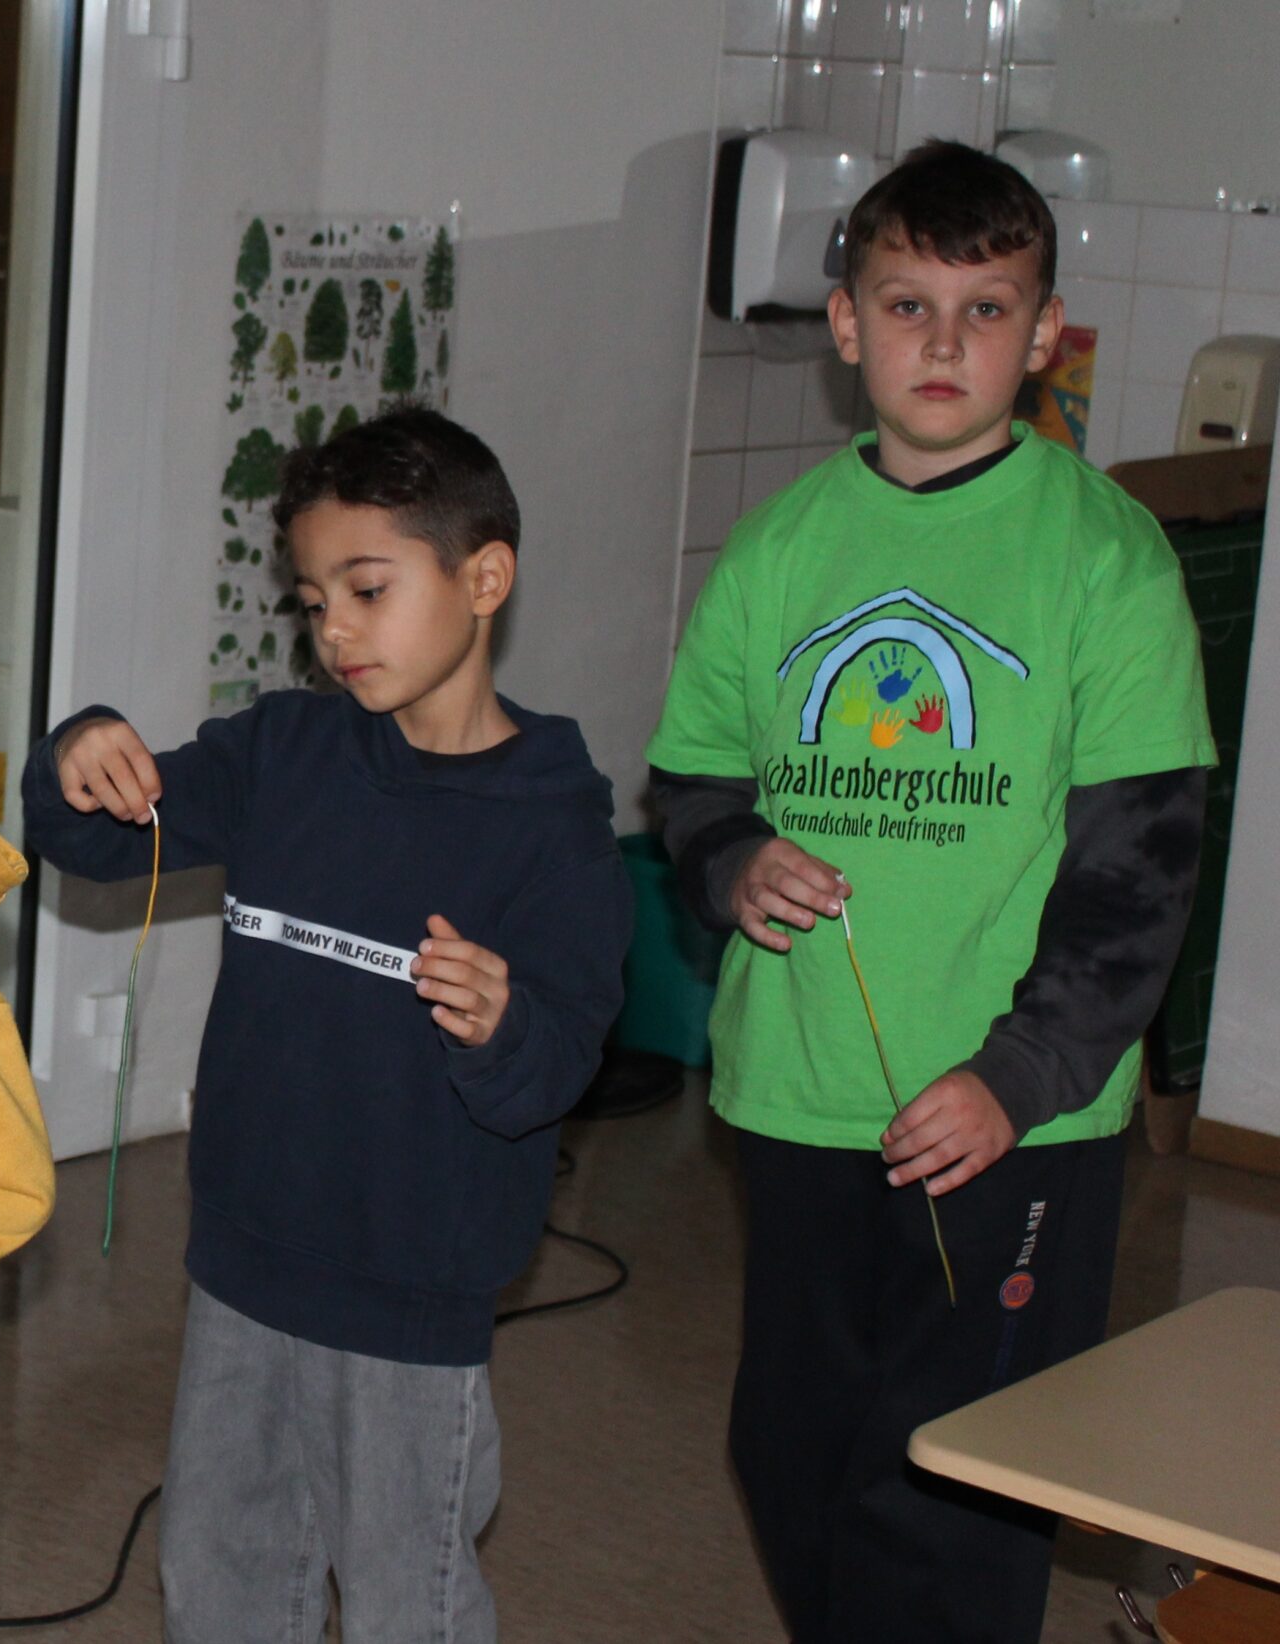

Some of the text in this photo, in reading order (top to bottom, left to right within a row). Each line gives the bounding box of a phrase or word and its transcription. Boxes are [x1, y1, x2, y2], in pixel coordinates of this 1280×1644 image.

[329, 248, 356, 269] und
[781, 807, 966, 847] Grundschule Deufringen
[281, 923, 333, 949] TOMMY
[333, 938, 403, 971] HILFIGER
[1026, 1201, 1046, 1231] NEW
